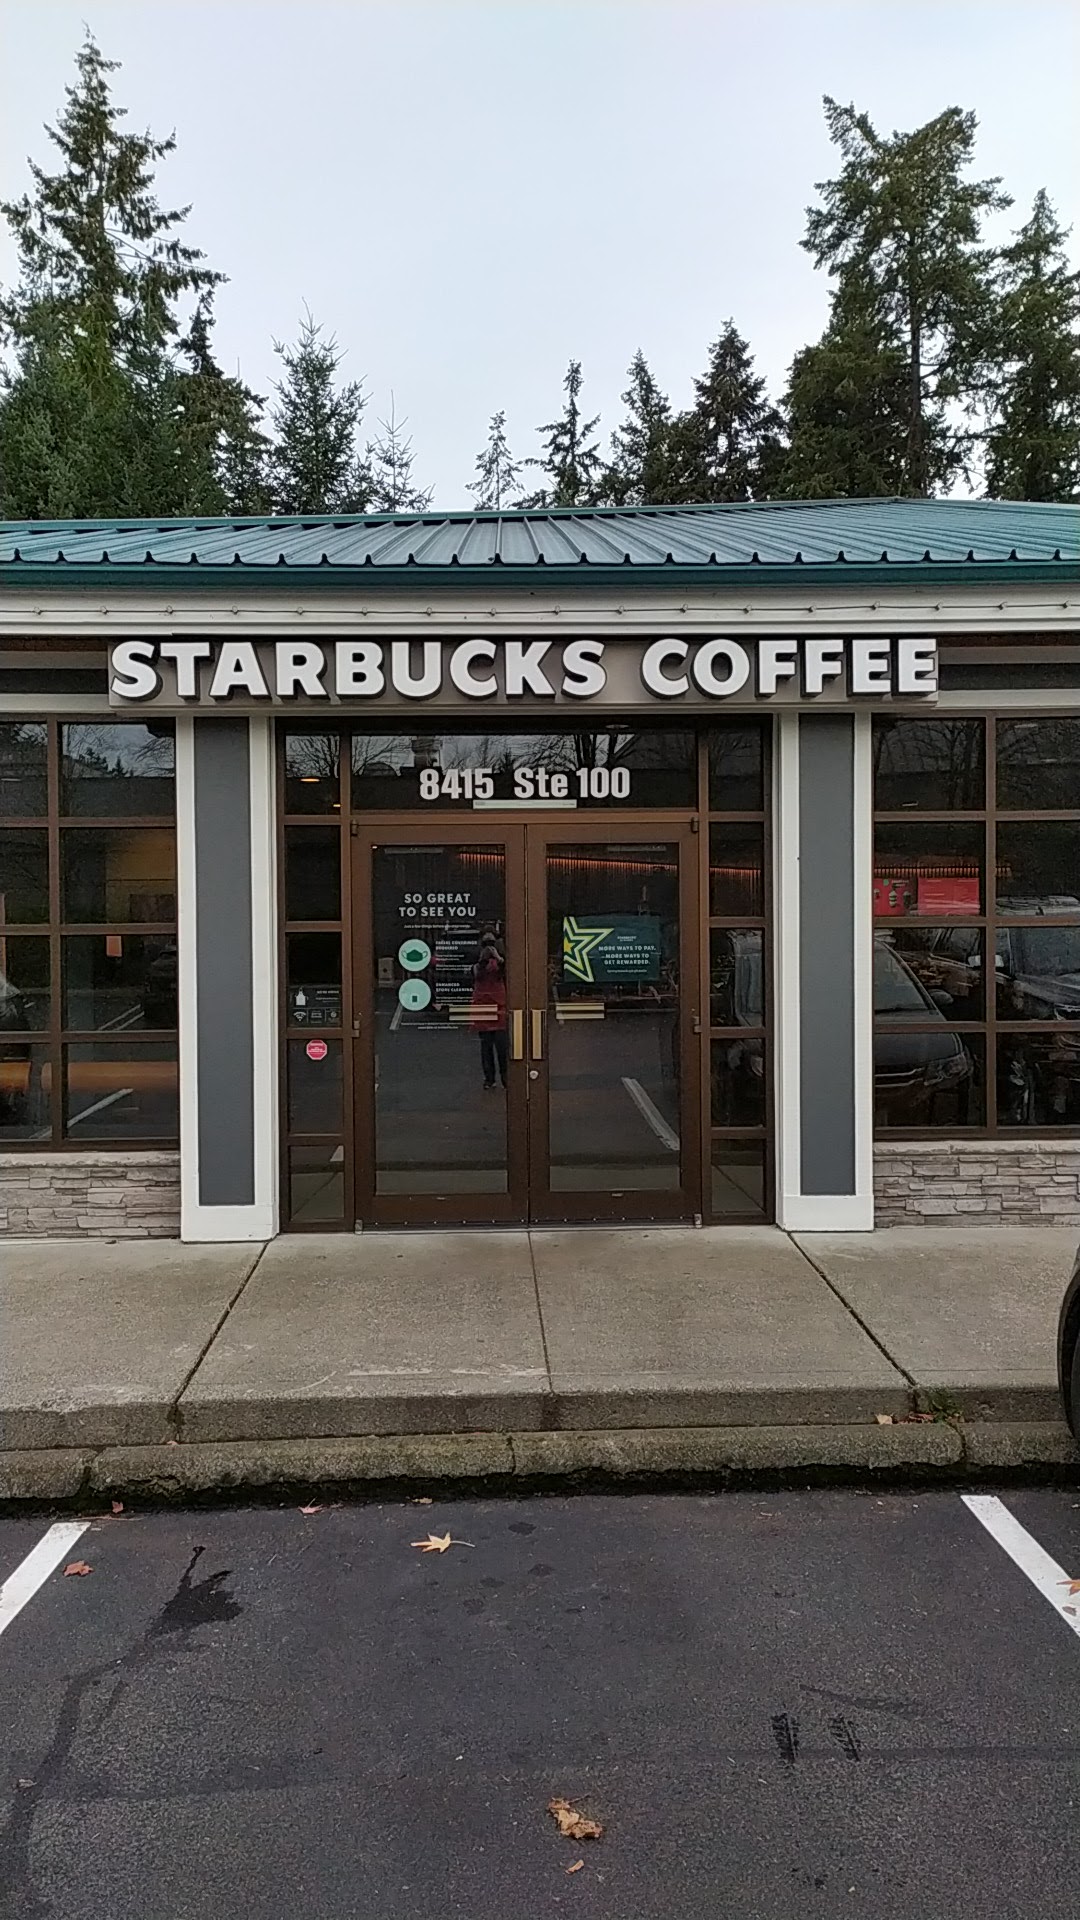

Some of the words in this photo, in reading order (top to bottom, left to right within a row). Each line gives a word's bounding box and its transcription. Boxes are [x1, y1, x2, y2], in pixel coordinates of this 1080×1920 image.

[110, 639, 607, 698] STARBUCKS
[641, 638, 938, 697] COFFEE
[419, 768, 494, 800] 8415
[513, 767, 569, 798] Ste
[576, 767, 630, 798] 100
[404, 893, 423, 904] SO
[427, 893, 471, 904] GREAT
[398, 906, 417, 917] TO
[420, 906, 444, 917] SEE
[448, 906, 476, 917] YOU
